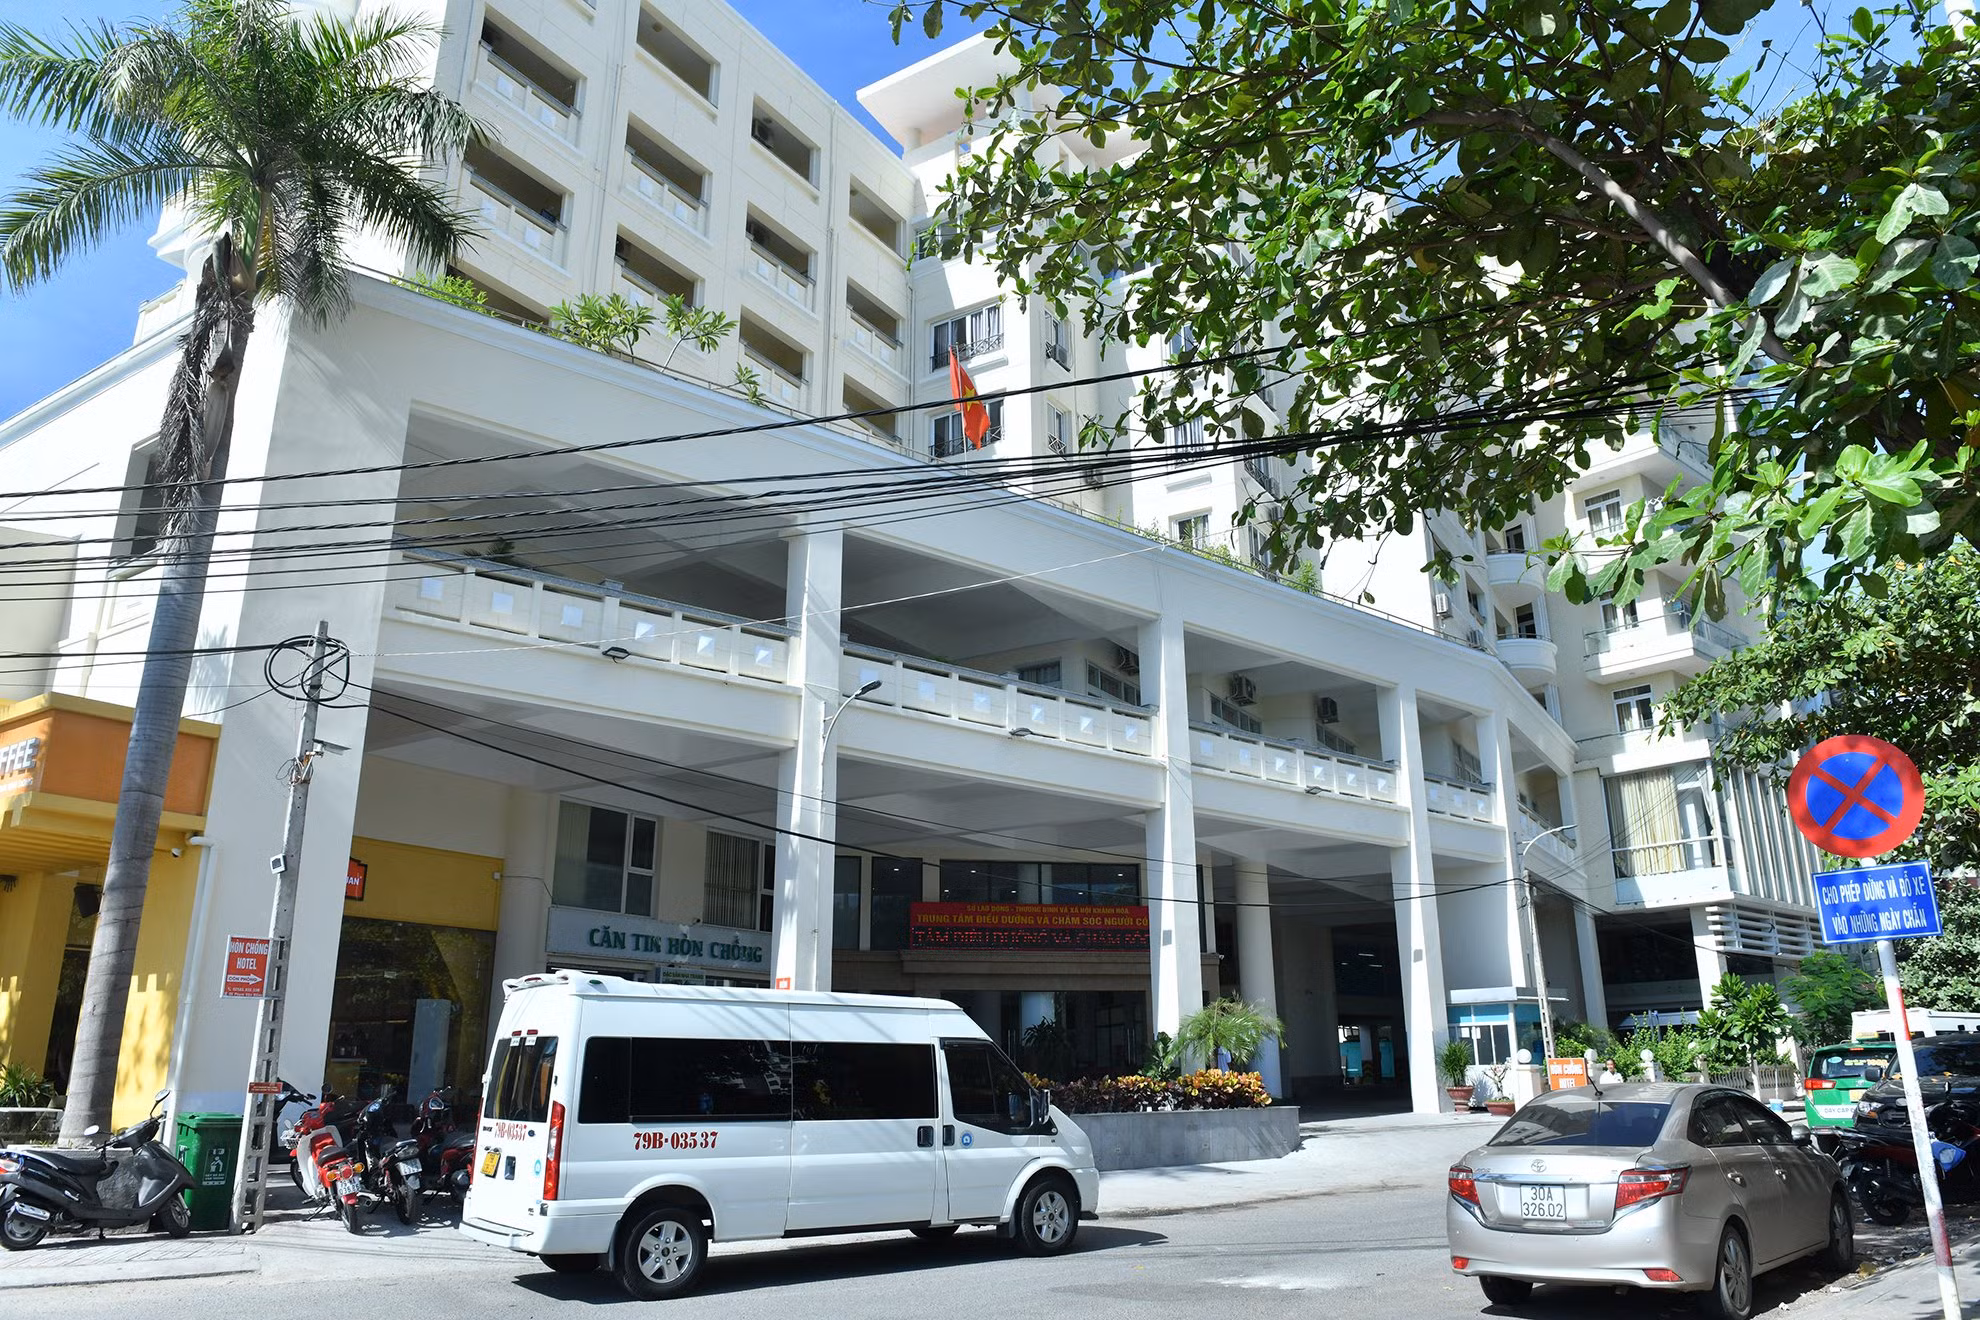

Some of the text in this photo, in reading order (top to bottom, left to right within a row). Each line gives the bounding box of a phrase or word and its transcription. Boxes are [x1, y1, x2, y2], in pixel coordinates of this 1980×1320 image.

[1821, 885, 1839, 906] CHO
[1840, 879, 1861, 904] PHÉP
[1862, 874, 1887, 901] DỪNG
[1886, 875, 1899, 899] VÀ
[1912, 876, 1927, 896] XE
[916, 914, 949, 924] TRUNG
[953, 912, 973, 924] TÂM
[1036, 913, 1050, 925] VÀ
[1083, 913, 1102, 926] SÓC
[1831, 911, 1849, 936] VÀO
[1849, 909, 1879, 934] NHỮNG
[1879, 907, 1902, 931] NGÀY
[229, 938, 245, 954] HÒN
[589, 925, 626, 950] CĂN
[631, 932, 662, 953] TIN
[667, 932, 704, 957] HÒN
[236, 957, 257, 970] HOTEL
[1530, 1186, 1554, 1202] 30A
[1522, 1202, 1564, 1218] 326.02
